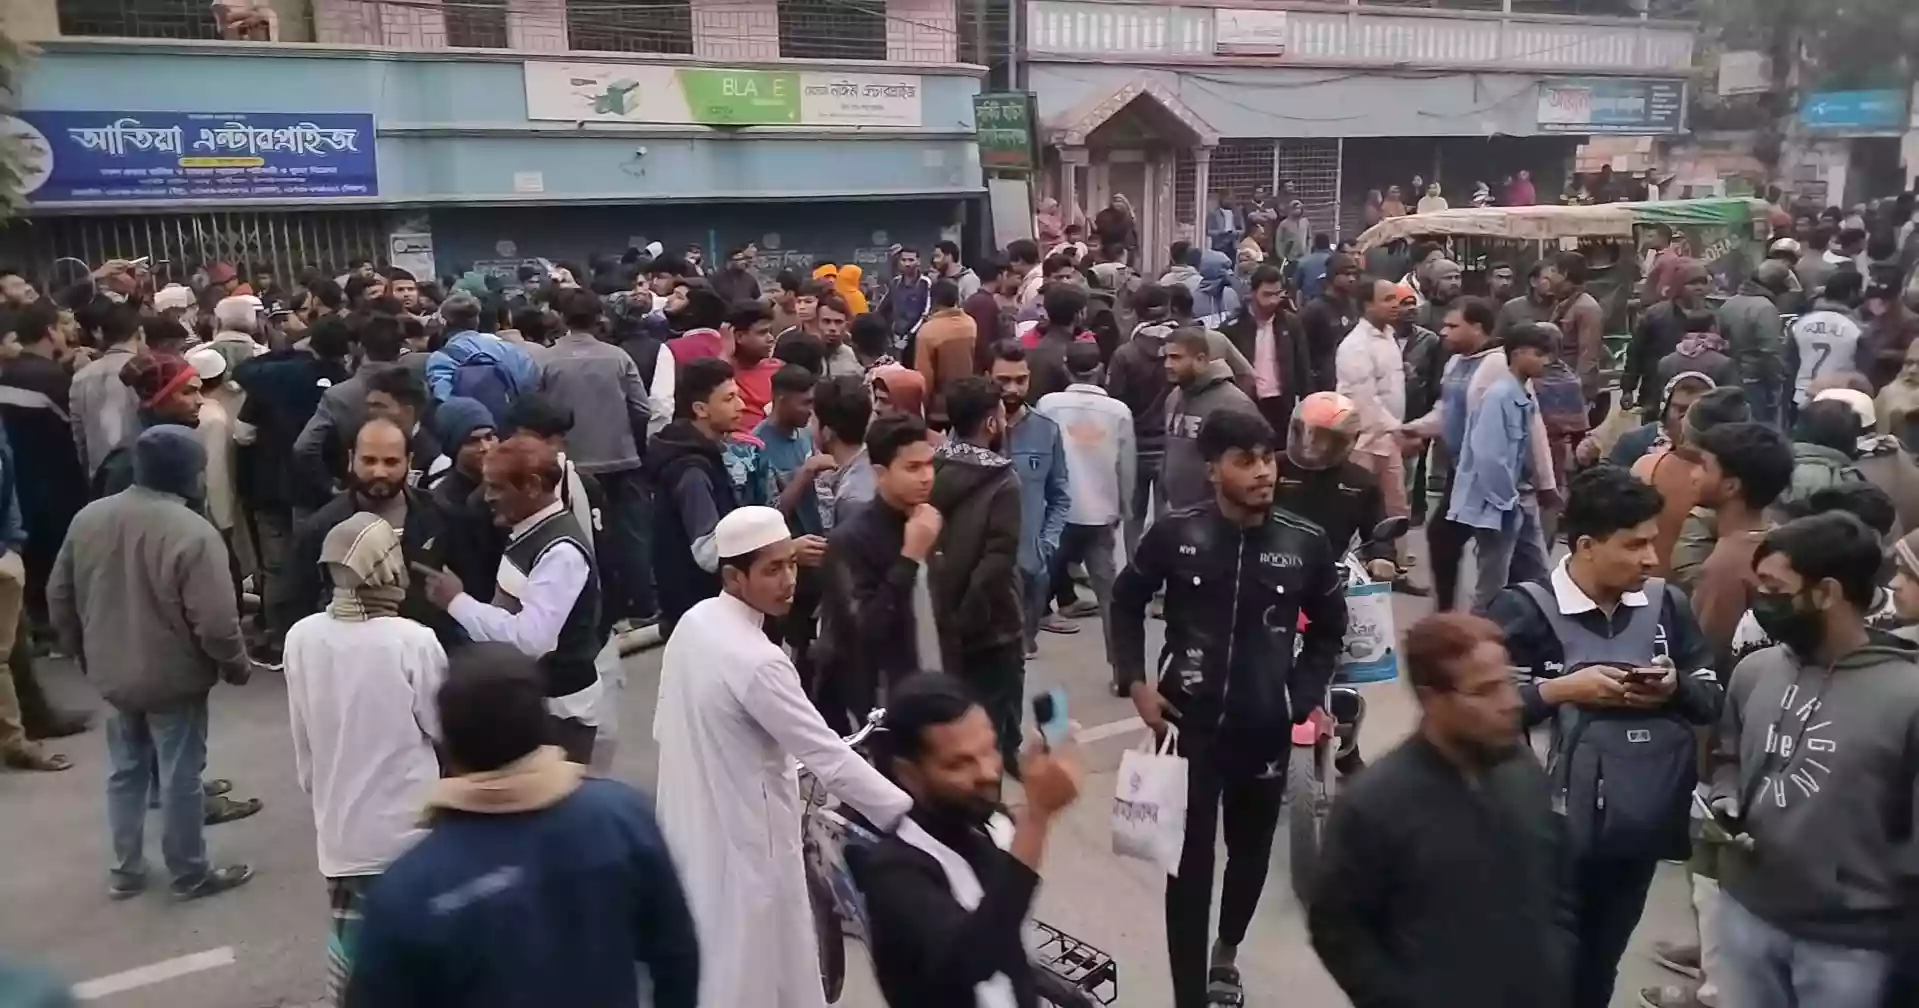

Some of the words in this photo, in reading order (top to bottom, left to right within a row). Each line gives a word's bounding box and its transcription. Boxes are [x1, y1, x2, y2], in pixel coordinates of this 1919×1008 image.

[722, 77, 787, 97] BLAE
[193, 121, 359, 156] এন্টারপ্রাইজ
[1812, 342, 1831, 381] 7
